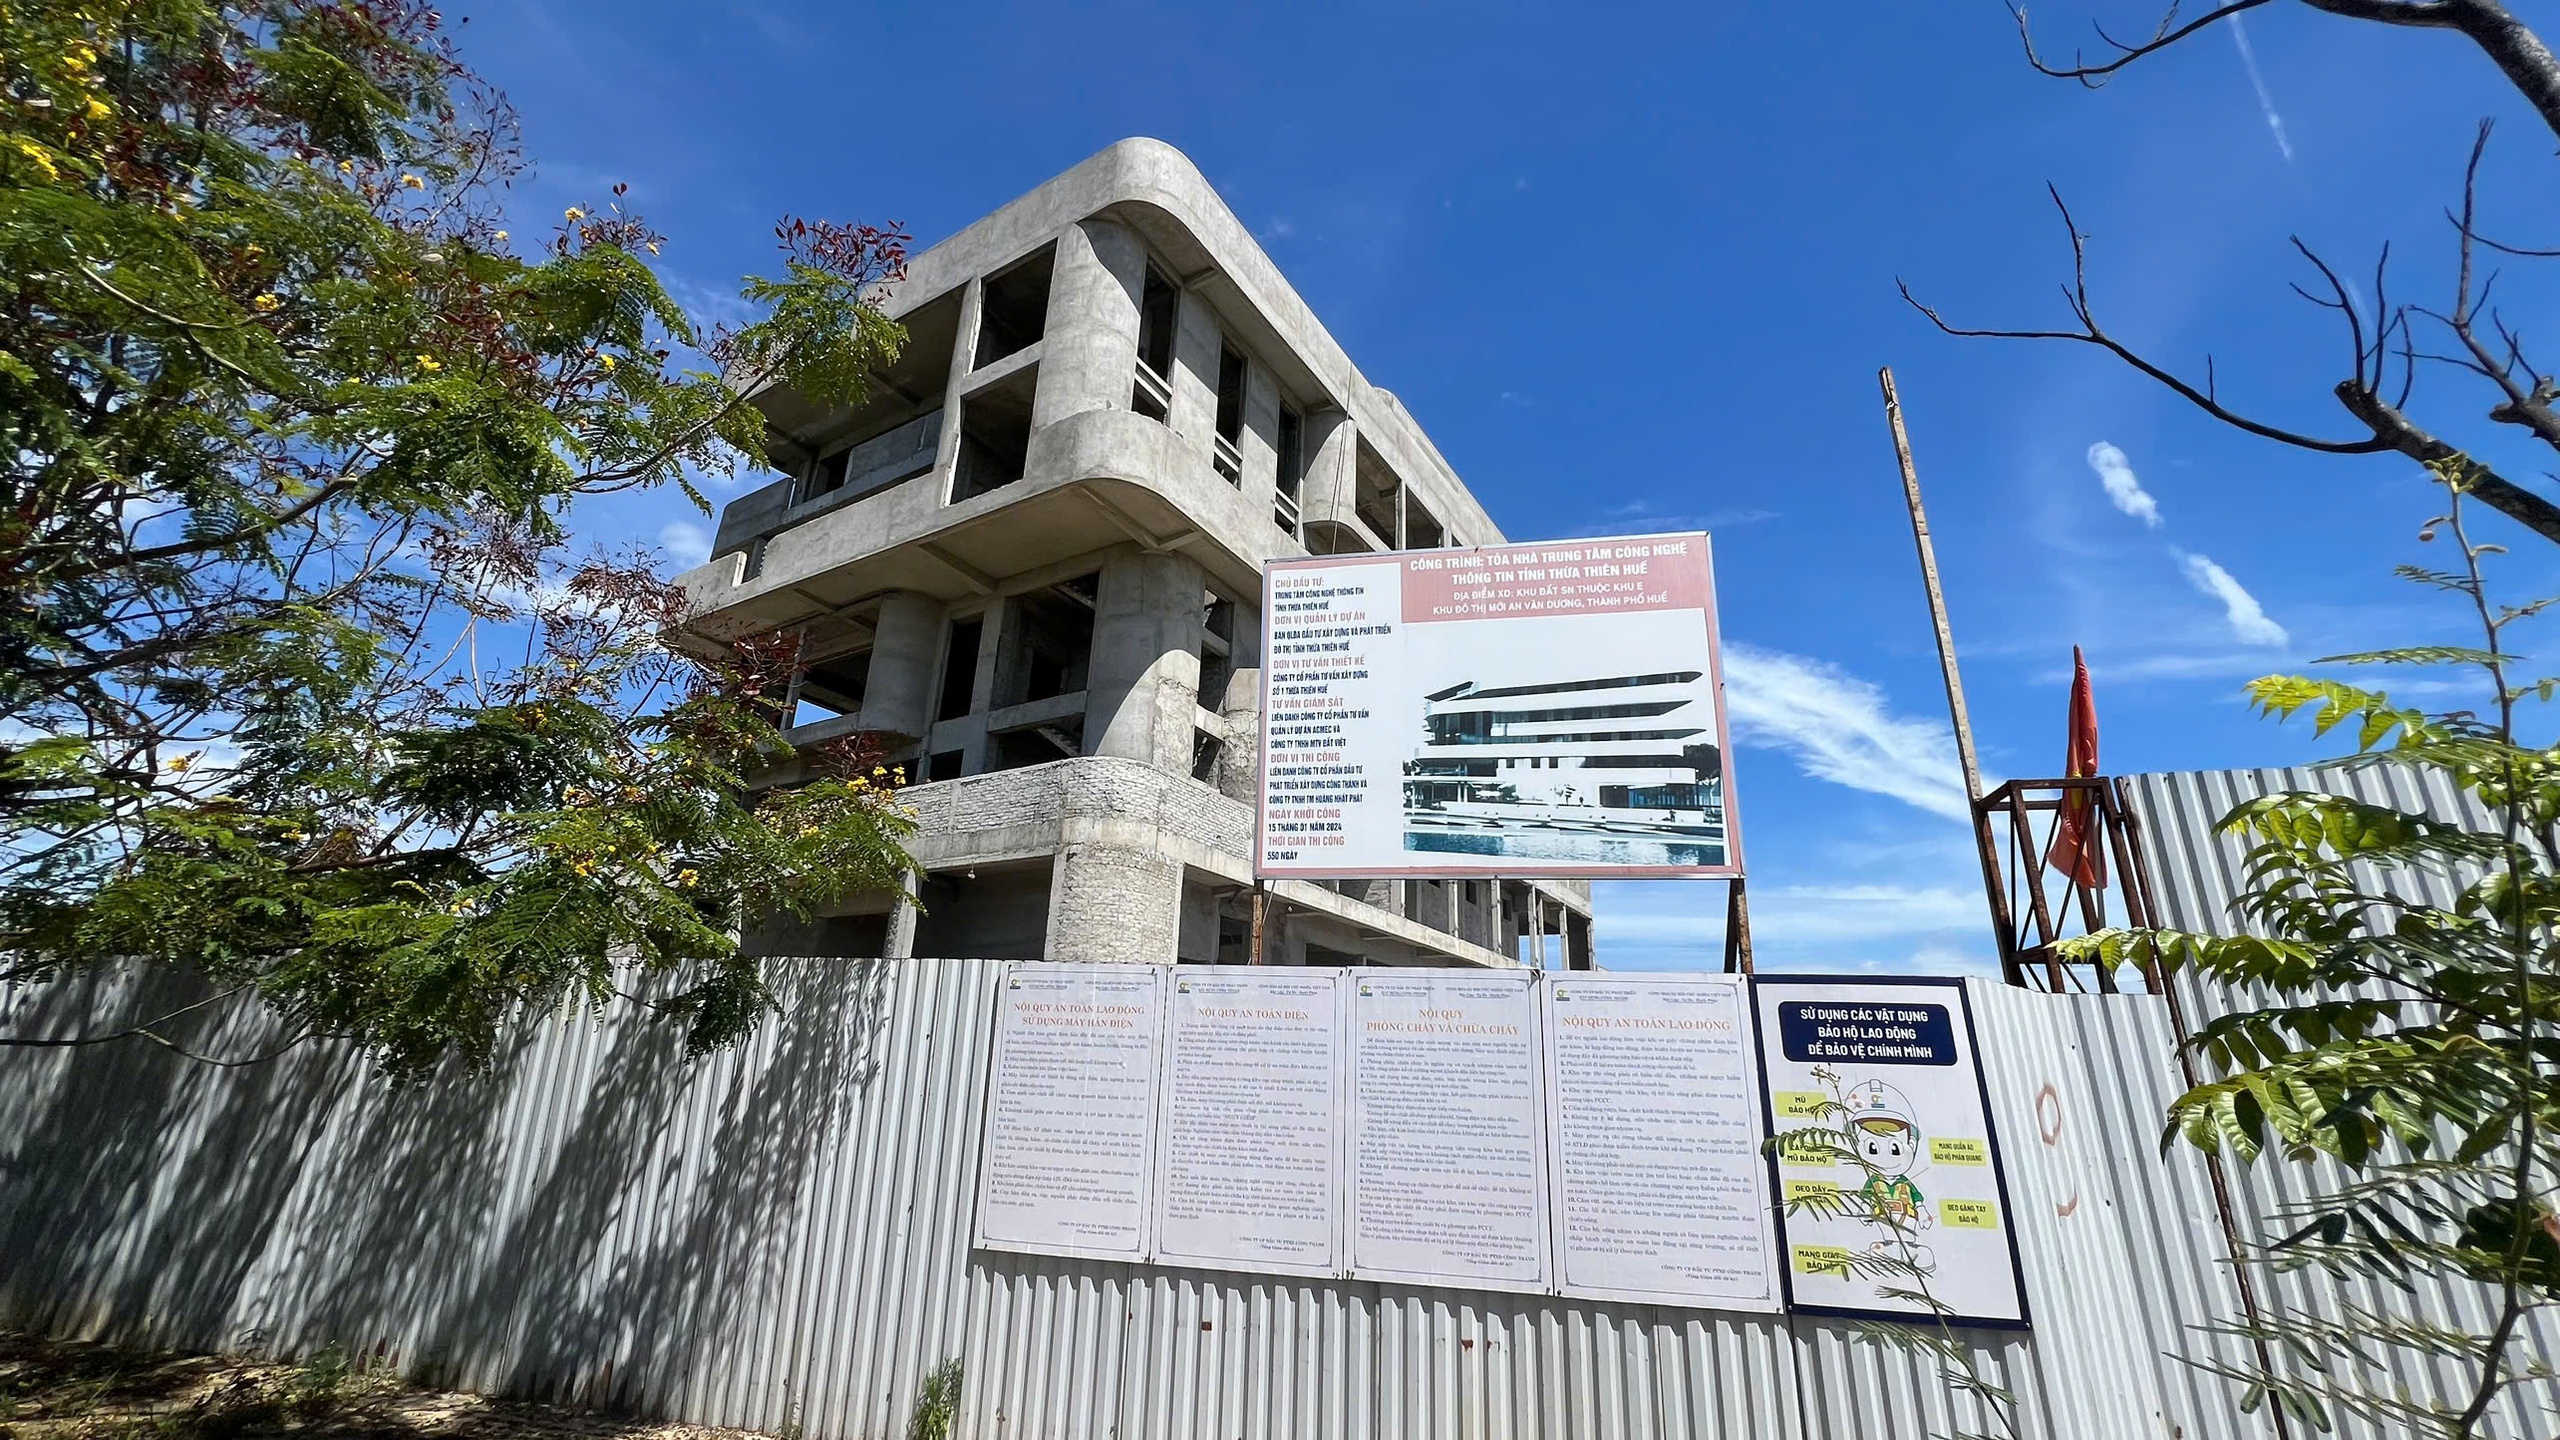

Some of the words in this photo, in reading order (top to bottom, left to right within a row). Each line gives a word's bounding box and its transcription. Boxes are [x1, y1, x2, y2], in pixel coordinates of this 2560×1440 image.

[1411, 558, 1442, 570] CÔNG
[1446, 555, 1483, 568] TRÌNH:
[1487, 553, 1509, 566] TÒA
[1513, 551, 1538, 564] NHÀ
[1543, 550, 1581, 562] TRUNG
[1585, 548, 1611, 560] TÂM
[1616, 546, 1649, 558] CÔNG
[1653, 543, 1687, 556] NGHỆ
[1452, 572, 1491, 585] THÔNG
[1494, 571, 1514, 582] TIN
[1517, 569, 1545, 581] TỈNH
[1548, 566, 1580, 579] THỪA
[1584, 564, 1619, 577] THIÊN
[1623, 560, 1648, 575] HUẾ
[1454, 591, 1469, 601] ĐỊA
[1472, 587, 1495, 599] ĐIỂM
[1517, 588, 1536, 596] KHU
[1539, 585, 1558, 596] ĐẤT
[1577, 584, 1610, 593] THUỘC
[1434, 606, 1452, 614] KHU
[1456, 604, 1468, 613] ĐÔ
[1471, 604, 1486, 613] THỊ
[1489, 602, 1506, 612] MỚI
[1526, 601, 1543, 609] VÂN
[1587, 595, 1620, 606] THÀNH
[1624, 594, 1644, 604] PHỐ
[1648, 591, 1667, 603] HUẾ
[1301, 754, 1313, 762] THI
[1317, 808, 1340, 818] CÔNG
[1269, 824, 1276, 832] 15
[1278, 823, 1298, 831] THÁNG
[1288, 837, 1306, 846] GIAN
[1309, 836, 1320, 845] THI
[1267, 852, 1279, 860] 550
[1014, 1004, 1030, 1012] NỘI
[1033, 1004, 1051, 1012] QUY
[1069, 1002, 1094, 1013] TOÀN
[1097, 1006, 1114, 1014] LAO
[1199, 1008, 1214, 1017] NỘI
[1218, 1009, 1238, 1018] QUY
[1257, 1009, 1281, 1018] TOÀN
[1420, 1008, 1438, 1019] NỘI
[1441, 1010, 1464, 1020] QUY
[1800, 1006, 1815, 1019] SỬ
[1818, 1009, 1848, 1023] DỤNG
[1851, 1008, 1872, 1020] CÁC
[1874, 1008, 1894, 1024] VẬT
[1898, 1010, 1928, 1024] DỤNG
[1563, 1015, 1583, 1027] NỘI
[1587, 1018, 1611, 1027] QUY
[1614, 1019, 1631, 1027] AN
[1634, 1017, 1665, 1028] TOÀN
[1670, 1020, 1692, 1029] LAO
[1818, 1024, 1840, 1038] BẢO
[1843, 1025, 1858, 1040] HỘ
[1861, 1028, 1882, 1038] LAO
[1886, 1027, 1916, 1042] ĐỘNG
[1808, 1040, 1823, 1055] ĐỂ
[1826, 1041, 1847, 1056] BẢO
[1850, 1044, 1866, 1058] VỆ
[1868, 1043, 1900, 1057] CHÍNH
[1904, 1046, 1932, 1058] MÌNH
